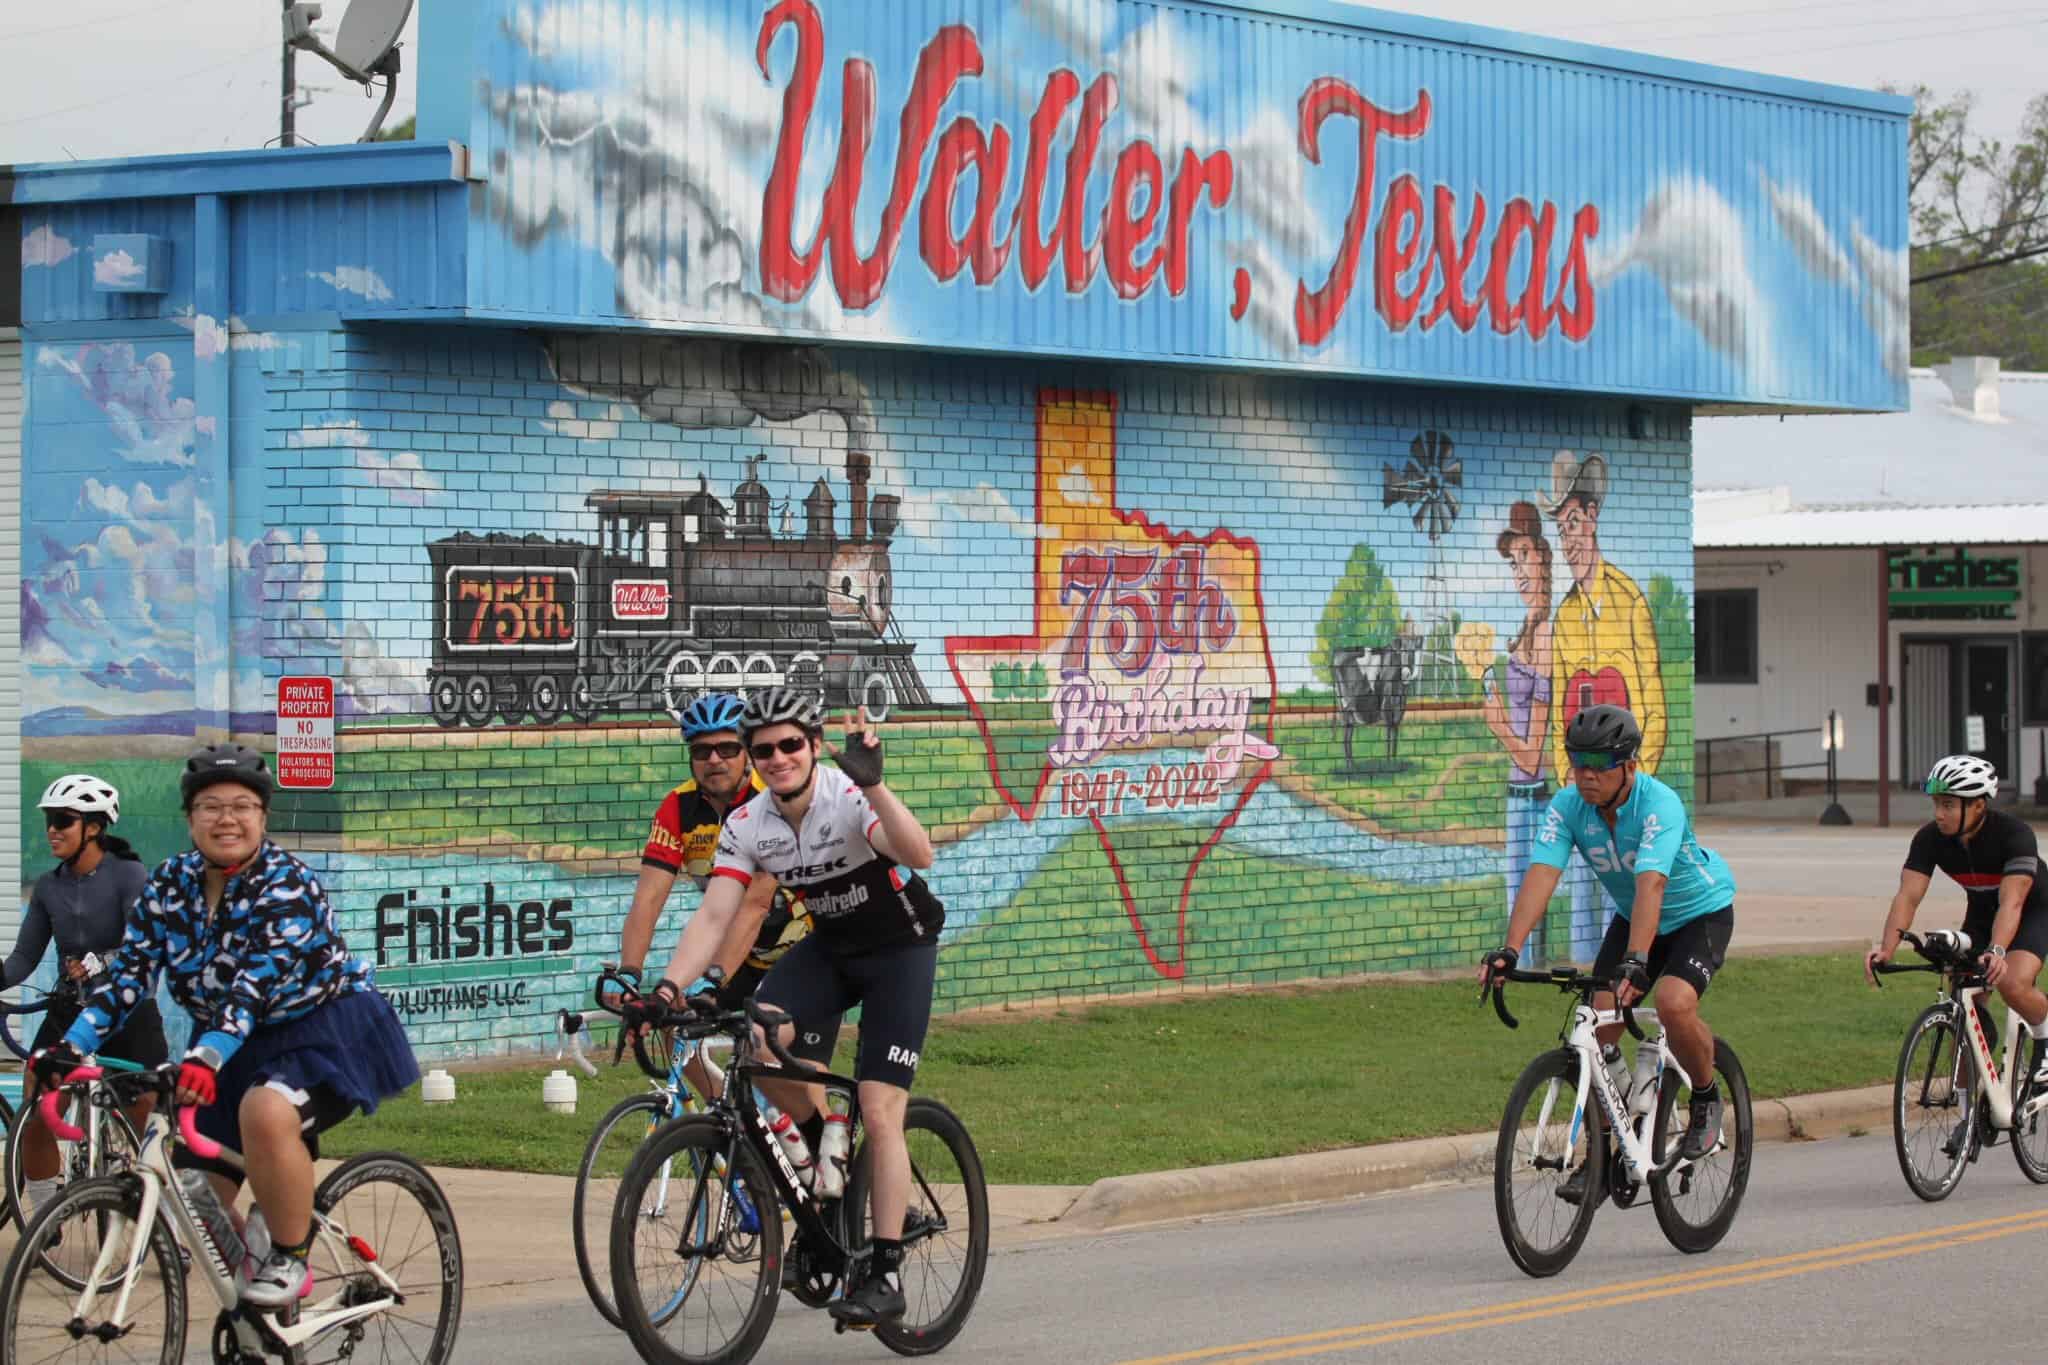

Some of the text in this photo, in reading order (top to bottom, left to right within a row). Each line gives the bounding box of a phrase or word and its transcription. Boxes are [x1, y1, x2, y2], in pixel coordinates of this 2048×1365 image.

[1297, 76, 1598, 346] Texas
[458, 574, 573, 646] 75th
[616, 585, 673, 615] Waller
[1060, 544, 1238, 680] 75th
[286, 686, 325, 700] PRIVATE
[281, 701, 330, 714] PROPERTY
[297, 721, 314, 734] NO
[1048, 652, 1280, 786] Birthday
[280, 736, 332, 750] TRESPASSING
[280, 767, 331, 779] BE PROSECUTED
[281, 756, 332, 768] VIOLATORS WILL
[376, 881, 574, 966] Finishes
